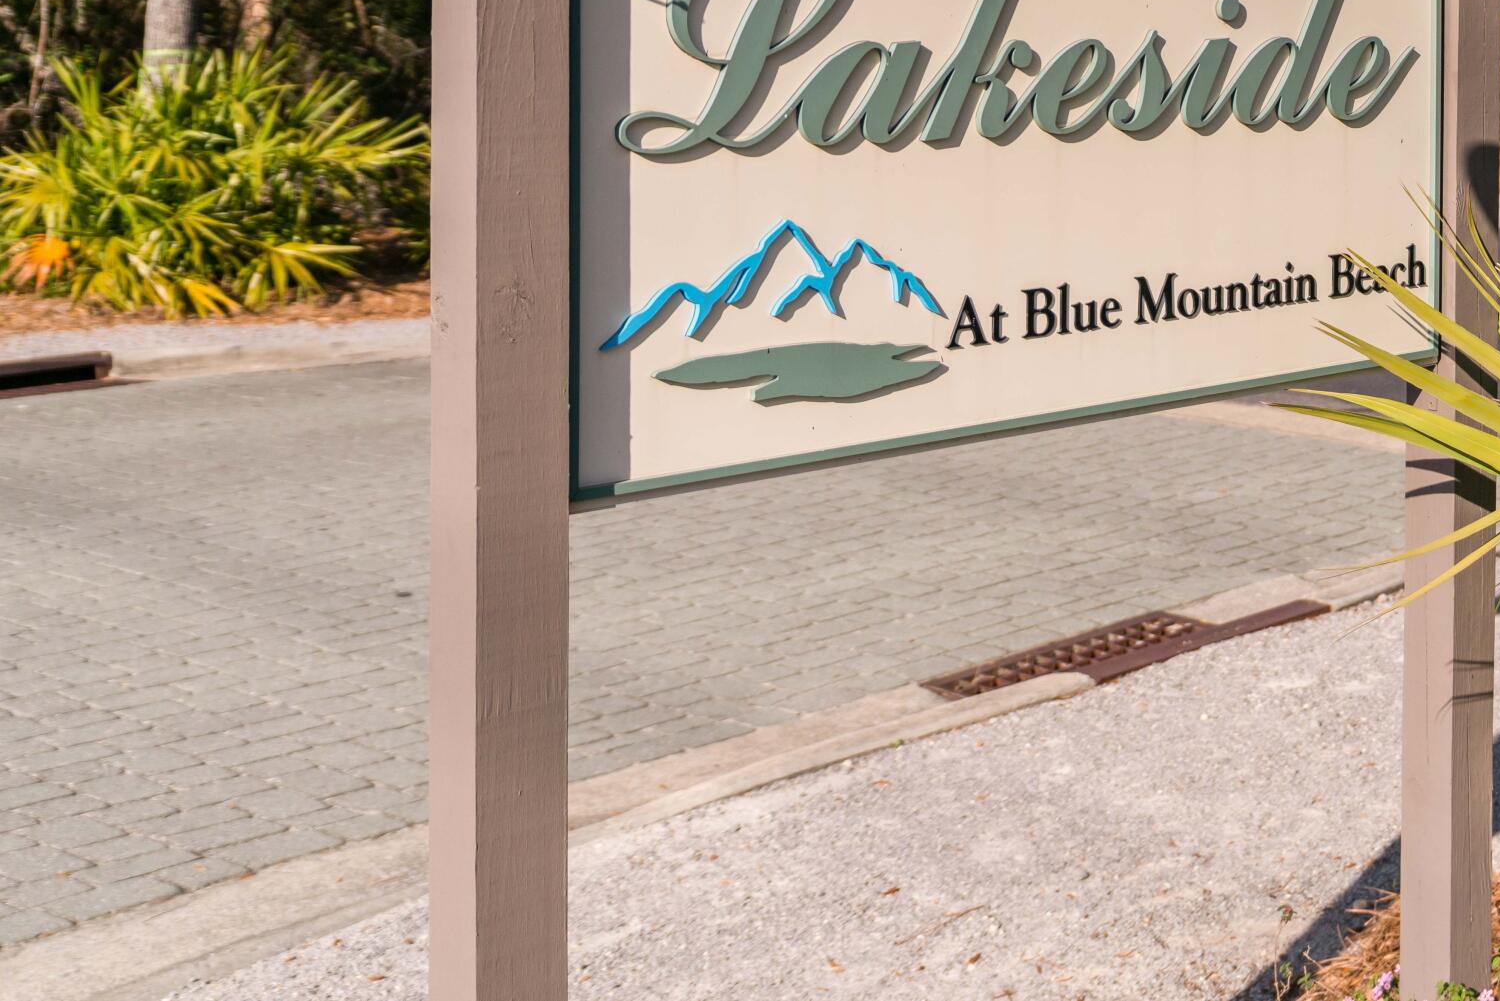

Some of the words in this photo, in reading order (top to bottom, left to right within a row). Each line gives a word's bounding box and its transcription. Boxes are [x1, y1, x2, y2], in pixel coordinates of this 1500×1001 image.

[946, 294, 1009, 349] At
[1021, 282, 1122, 340] Blue
[1134, 262, 1319, 325] Mountain
